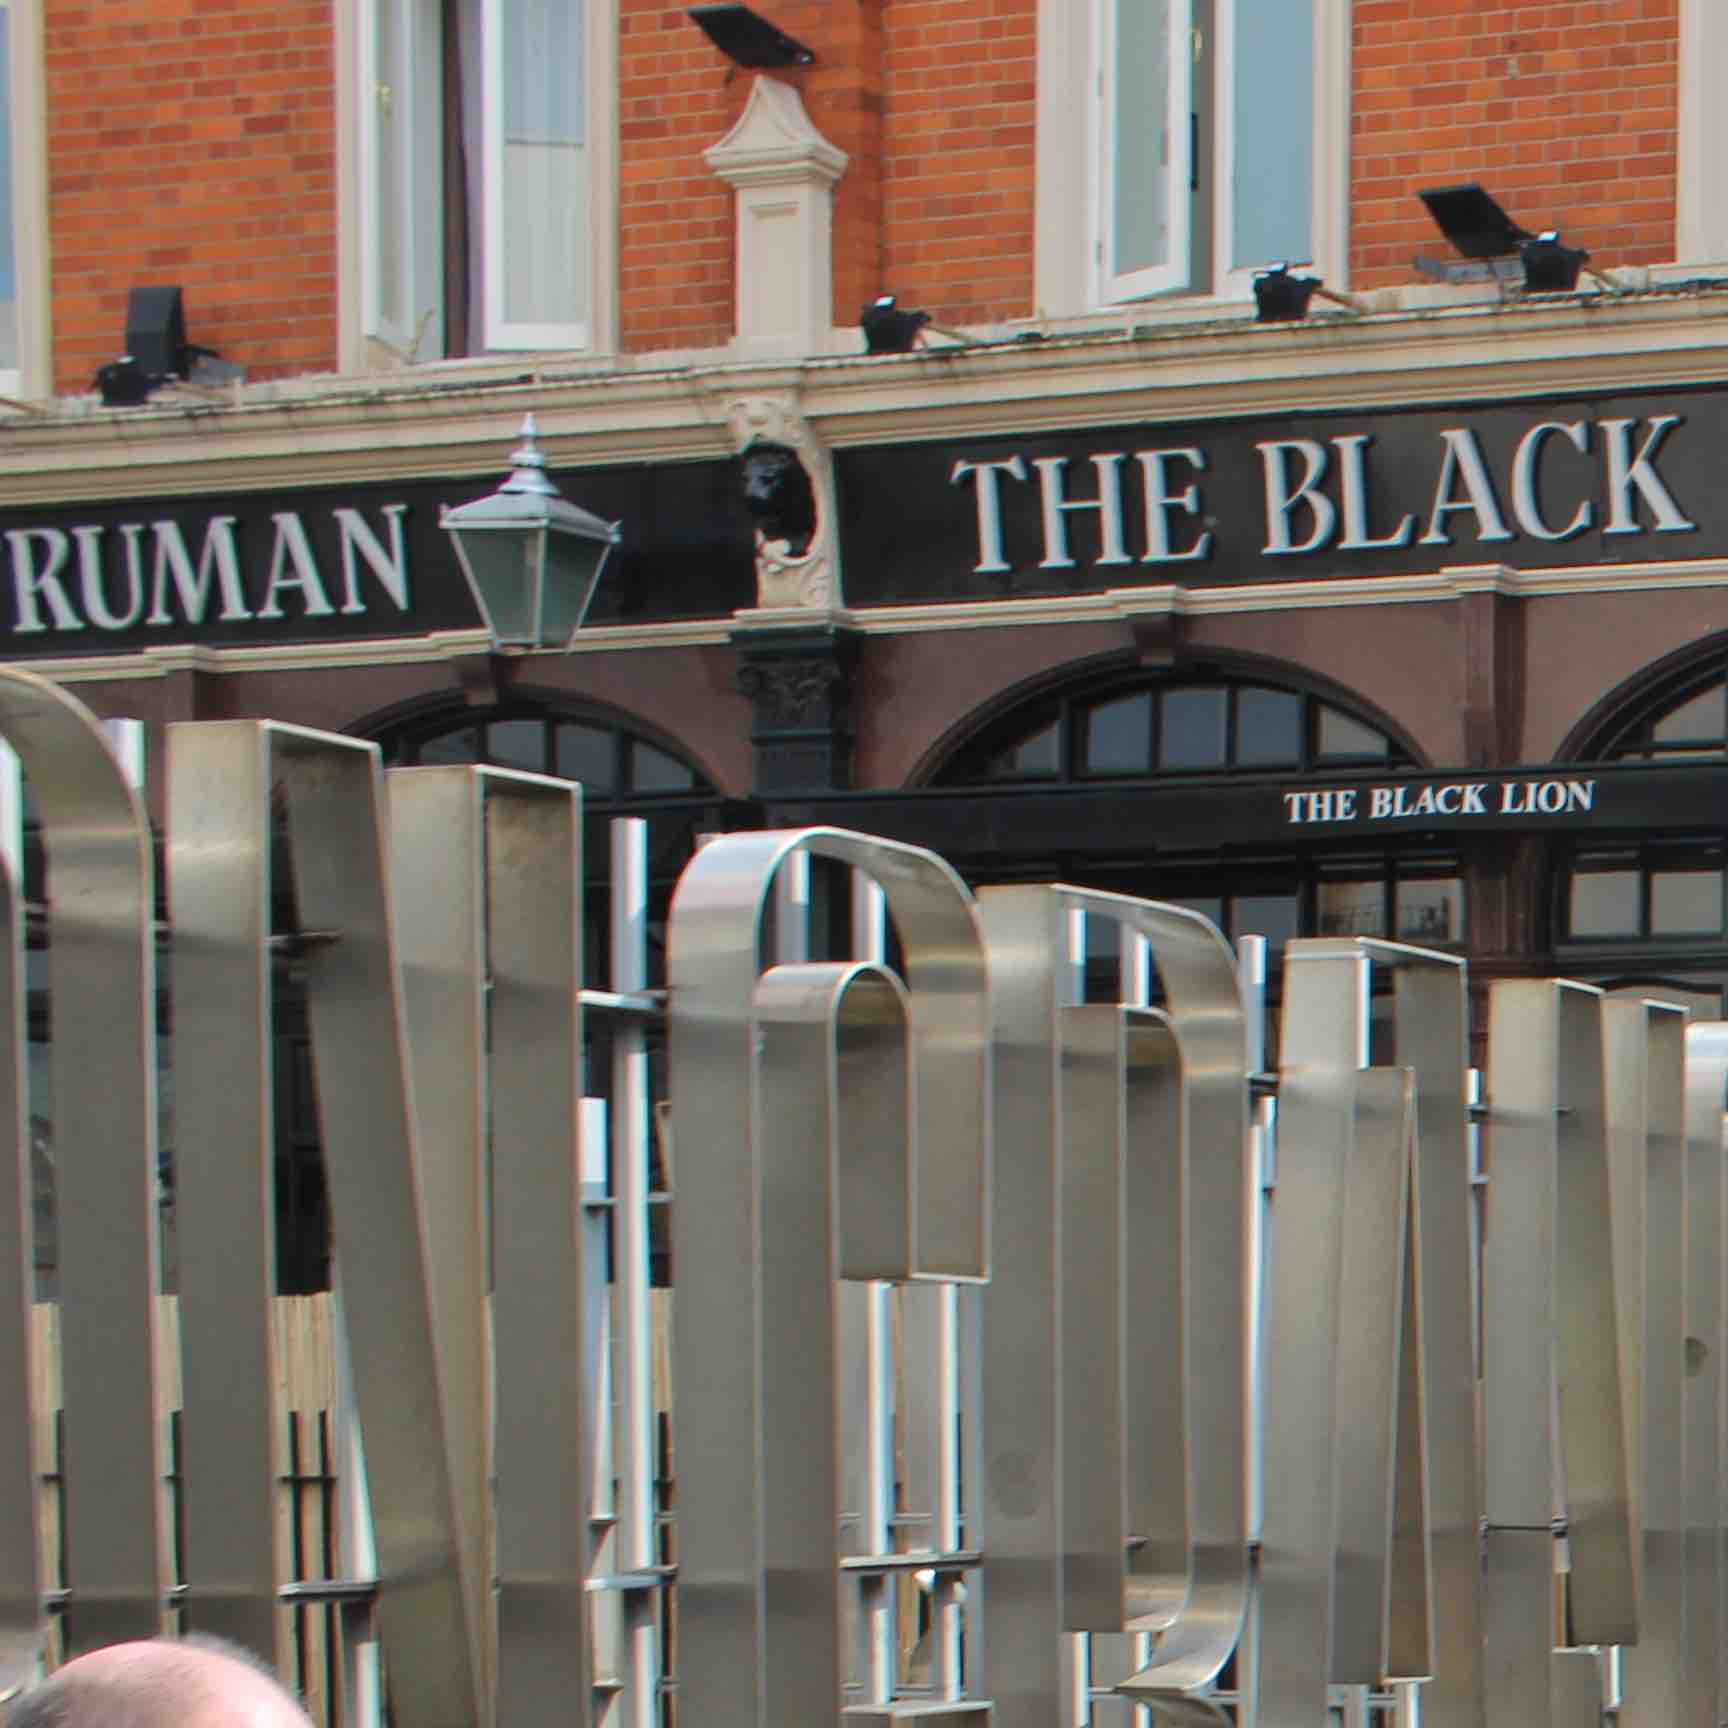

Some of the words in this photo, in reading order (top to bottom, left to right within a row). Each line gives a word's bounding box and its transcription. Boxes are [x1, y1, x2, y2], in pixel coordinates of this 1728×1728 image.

[949, 446, 1212, 575] THE
[1257, 411, 1696, 558] BLACK
[2, 503, 409, 633] RUMAN
[1283, 789, 1358, 826] THE
[1367, 781, 1488, 821] BLACK
[1499, 777, 1597, 814] LION
